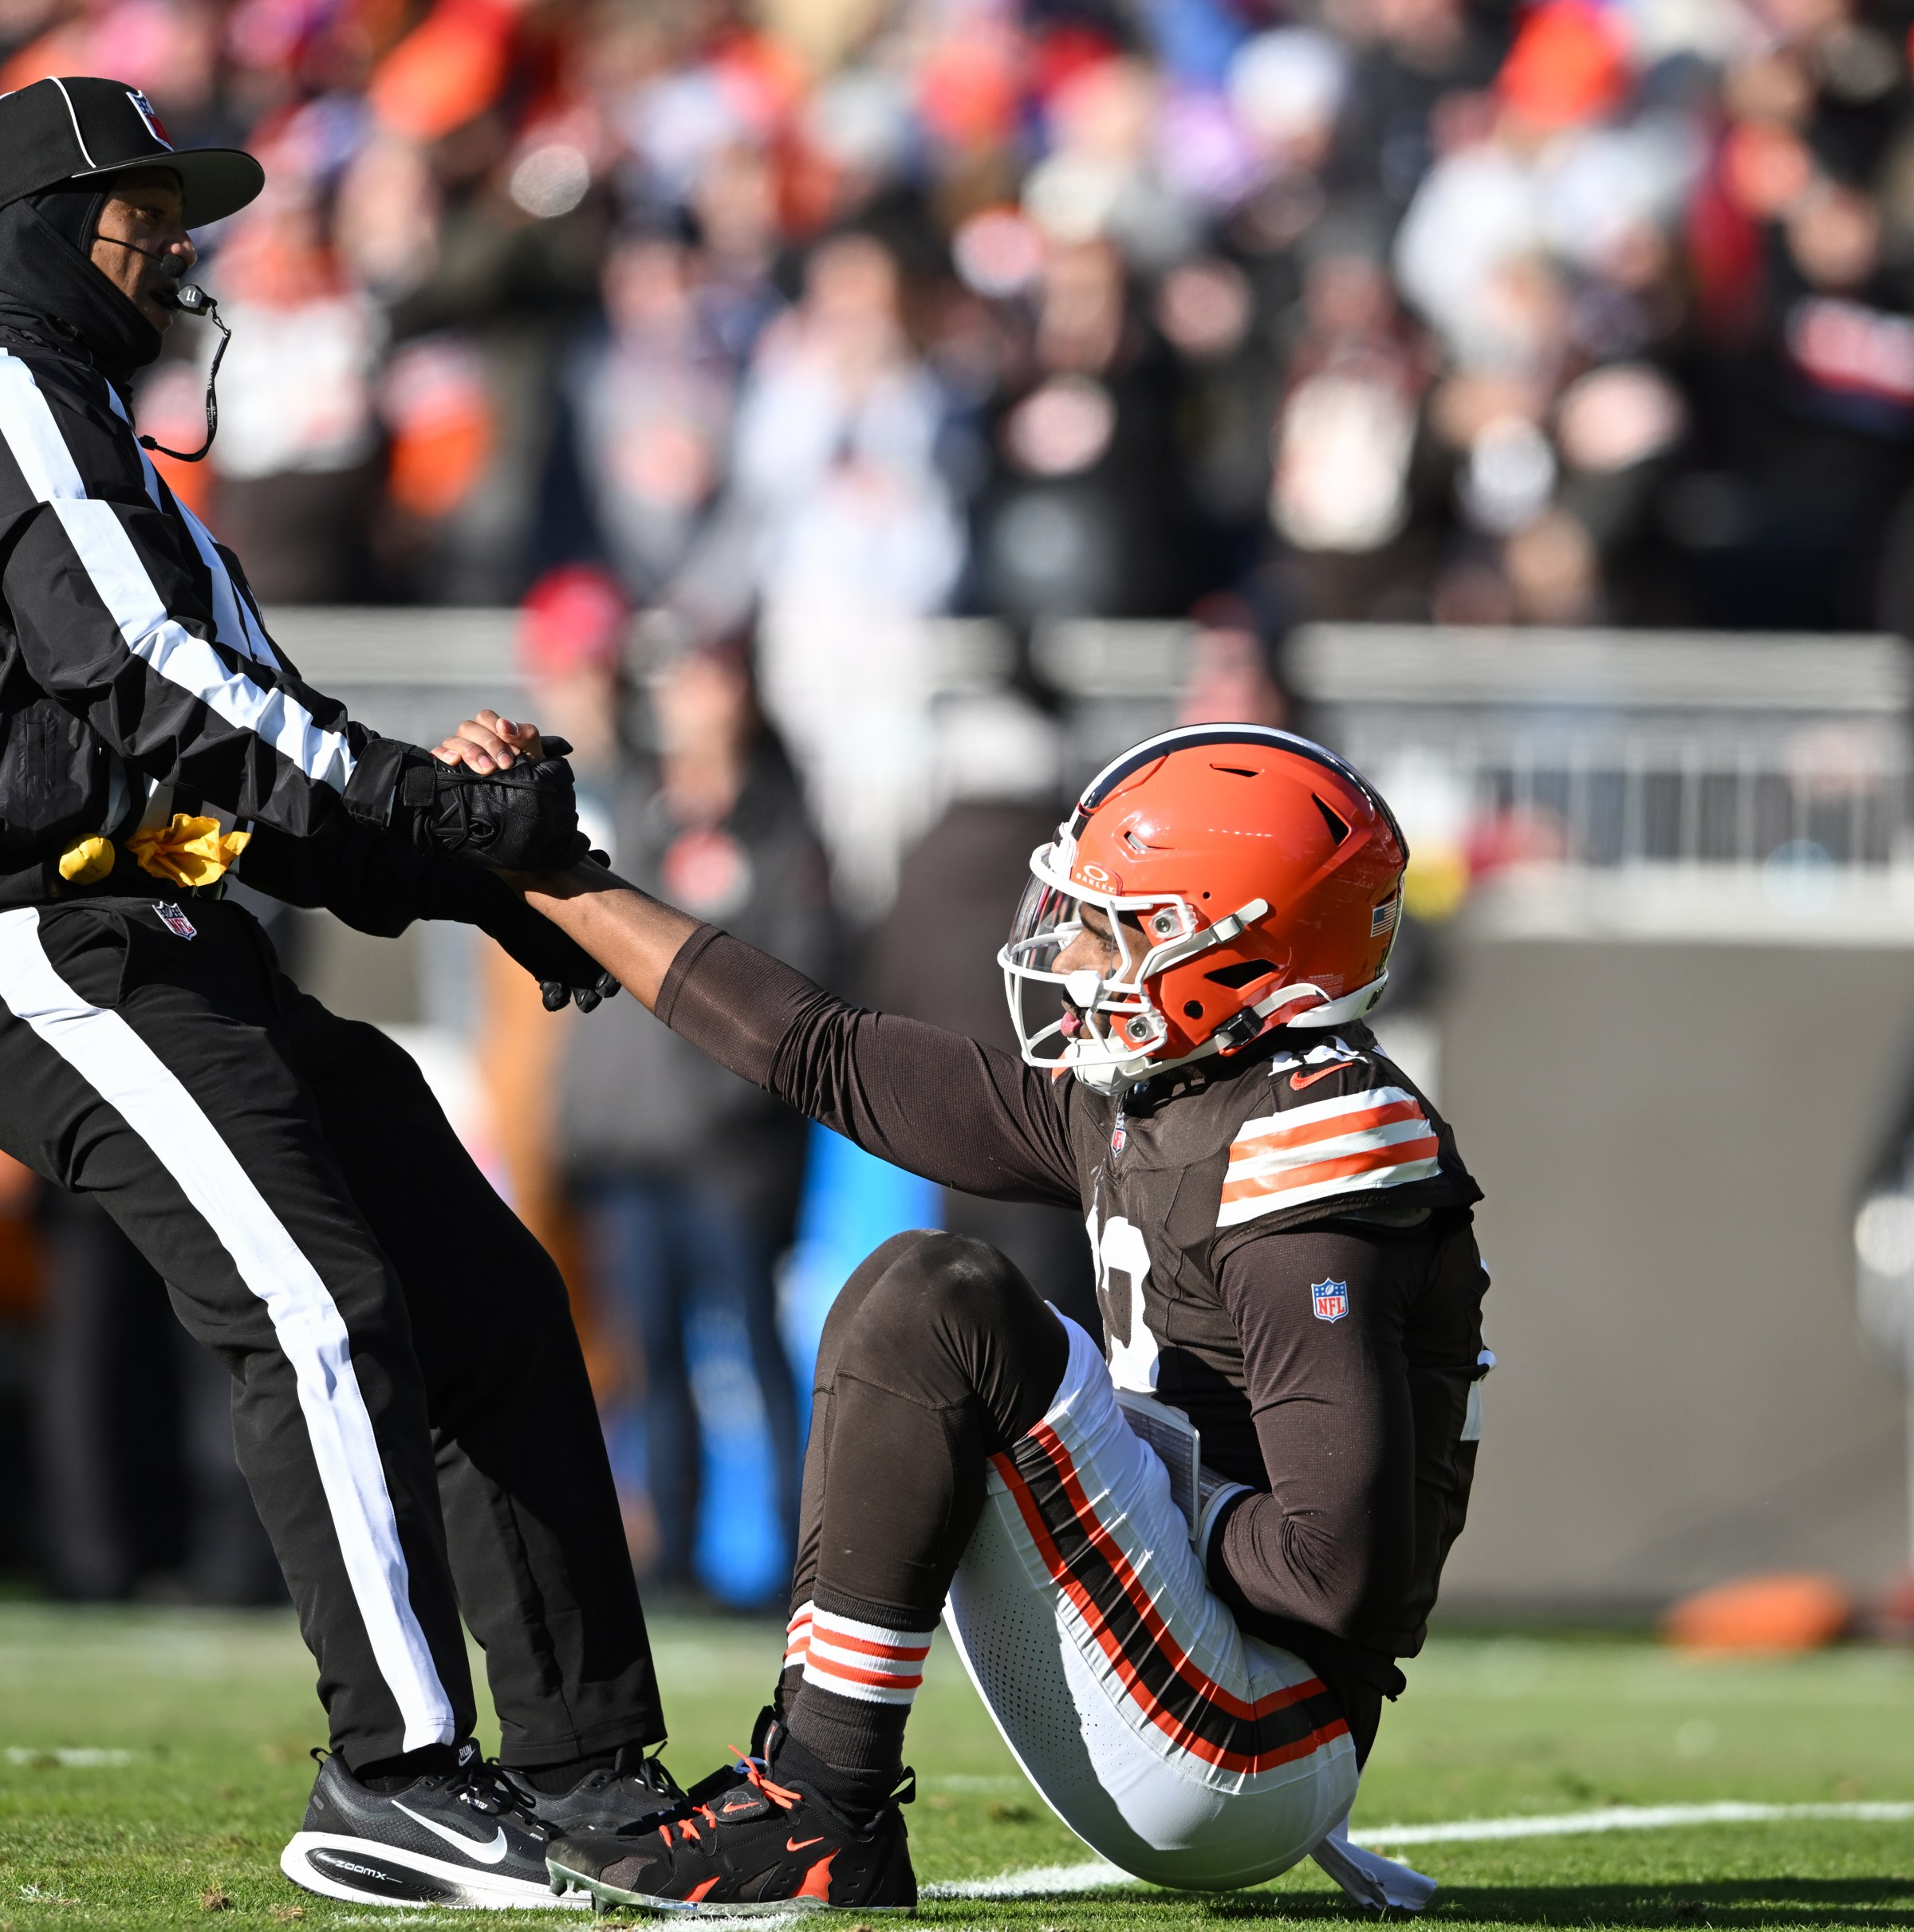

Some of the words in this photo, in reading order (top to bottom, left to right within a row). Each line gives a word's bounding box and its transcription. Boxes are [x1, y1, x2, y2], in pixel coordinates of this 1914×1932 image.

[1076, 872, 1114, 892] OAKLEY
[167, 918, 193, 934] NFL
[1317, 1297, 1345, 1316] NFL
[459, 1744, 473, 1758] RUN
